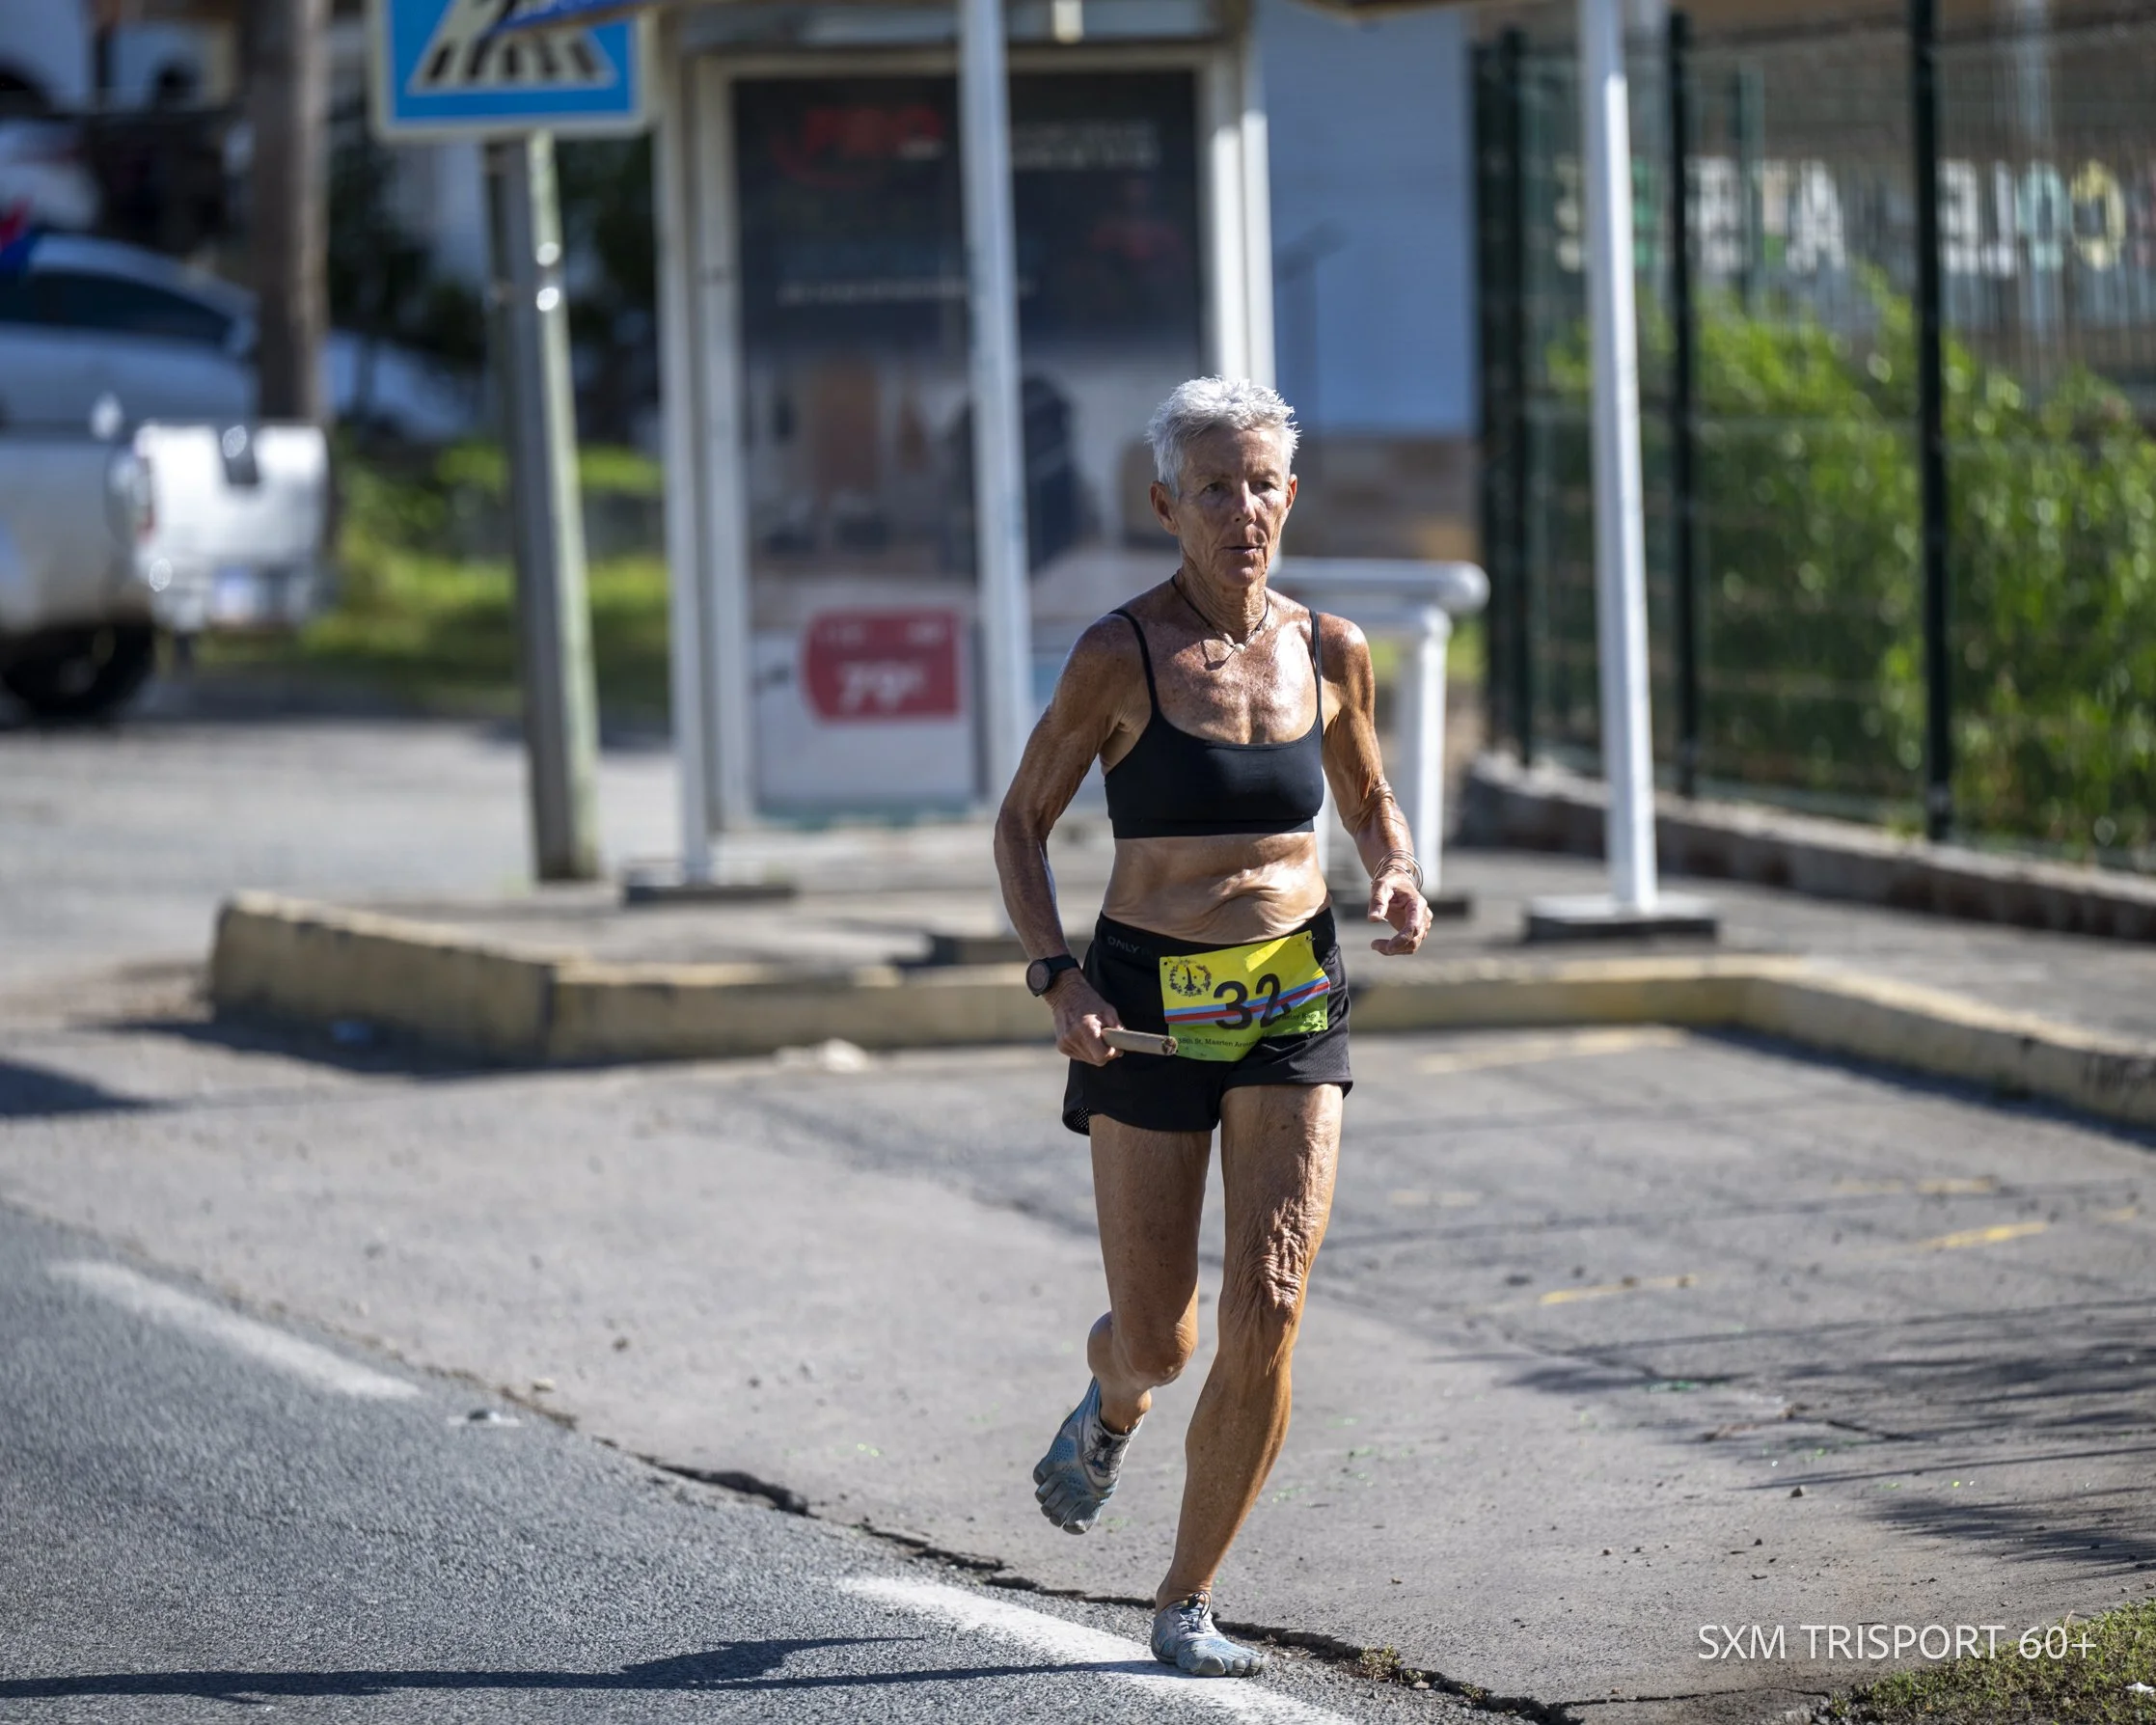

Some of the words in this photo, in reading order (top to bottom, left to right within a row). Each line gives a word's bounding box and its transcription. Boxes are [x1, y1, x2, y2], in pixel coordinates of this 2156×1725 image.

[1106, 936, 1140, 954] ONLY
[1213, 973, 1292, 1030] 32
[1205, 1038, 1234, 1048] Maarten
